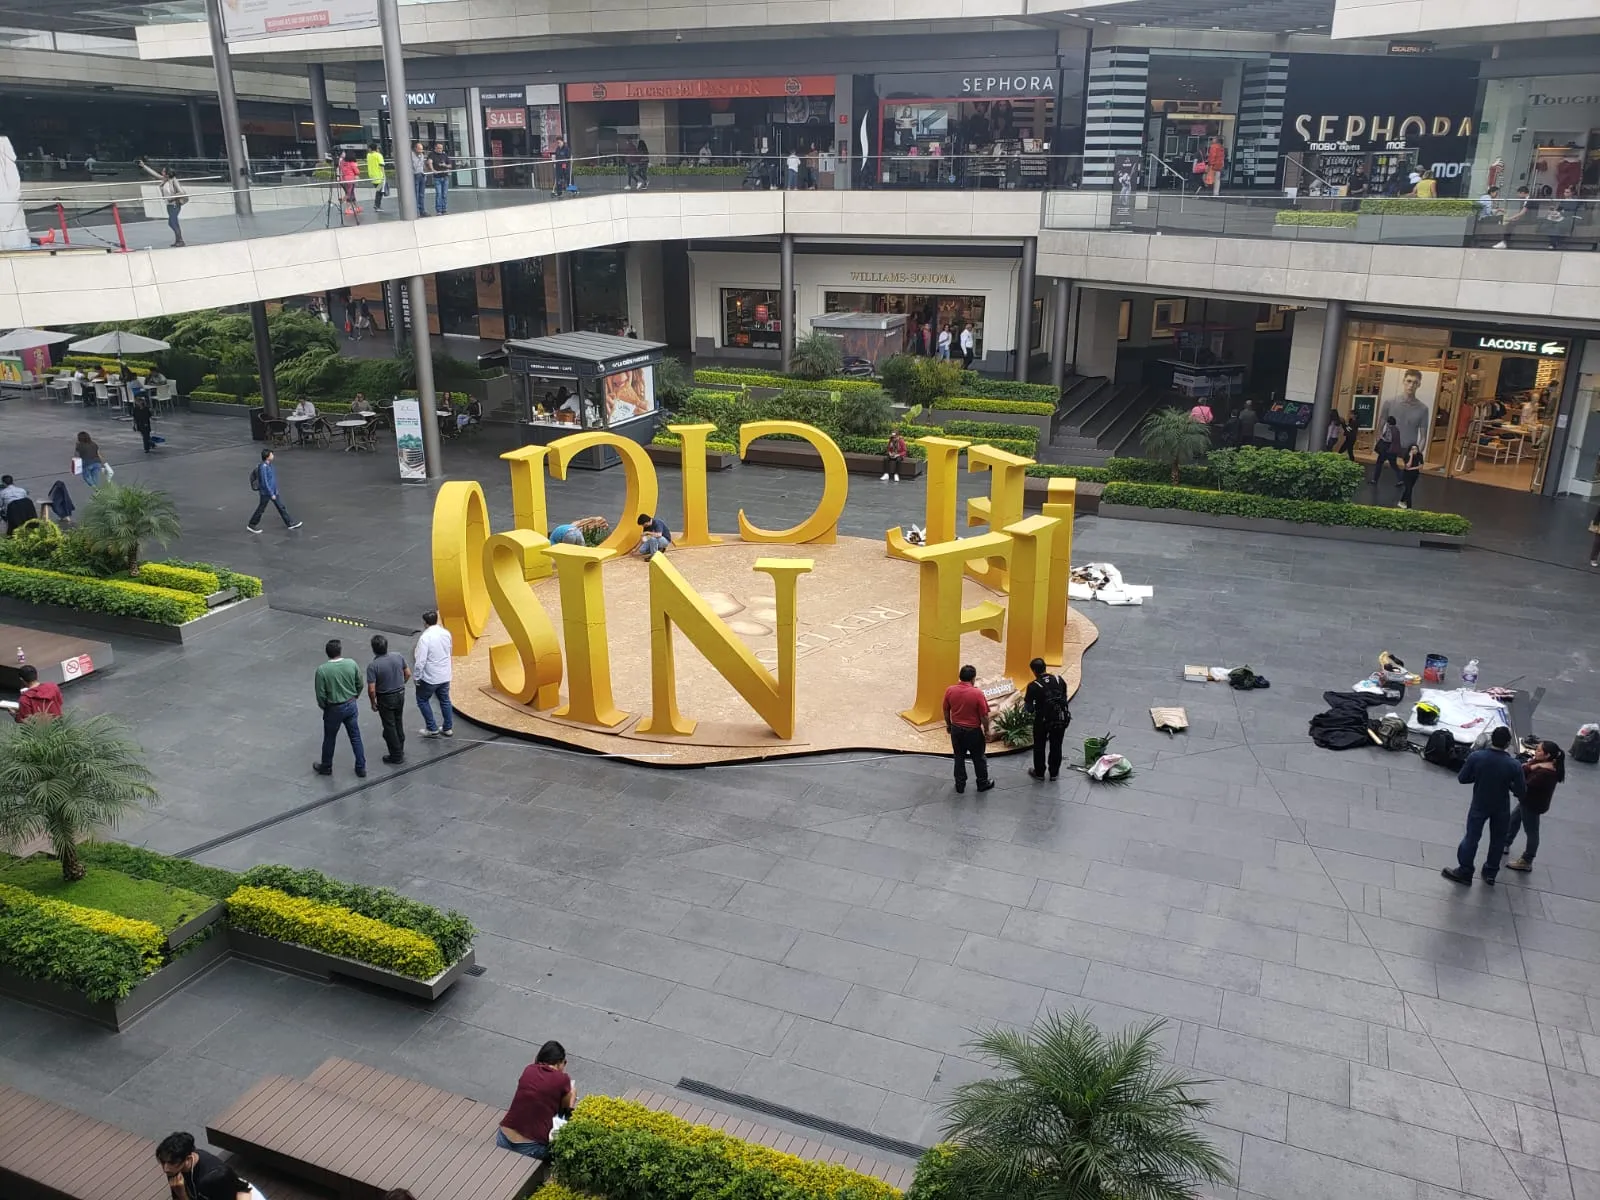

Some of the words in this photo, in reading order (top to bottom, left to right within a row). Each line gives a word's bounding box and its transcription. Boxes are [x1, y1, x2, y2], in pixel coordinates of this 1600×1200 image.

[962, 76, 1054, 92] SEPHORA
[381, 92, 436, 106] TMOLY
[490, 112, 523, 125] SALE
[850, 271, 957, 284] WILLIAMS-SONOMA
[1480, 337, 1538, 352] LACOSTE
[483, 529, 815, 739] SIN
